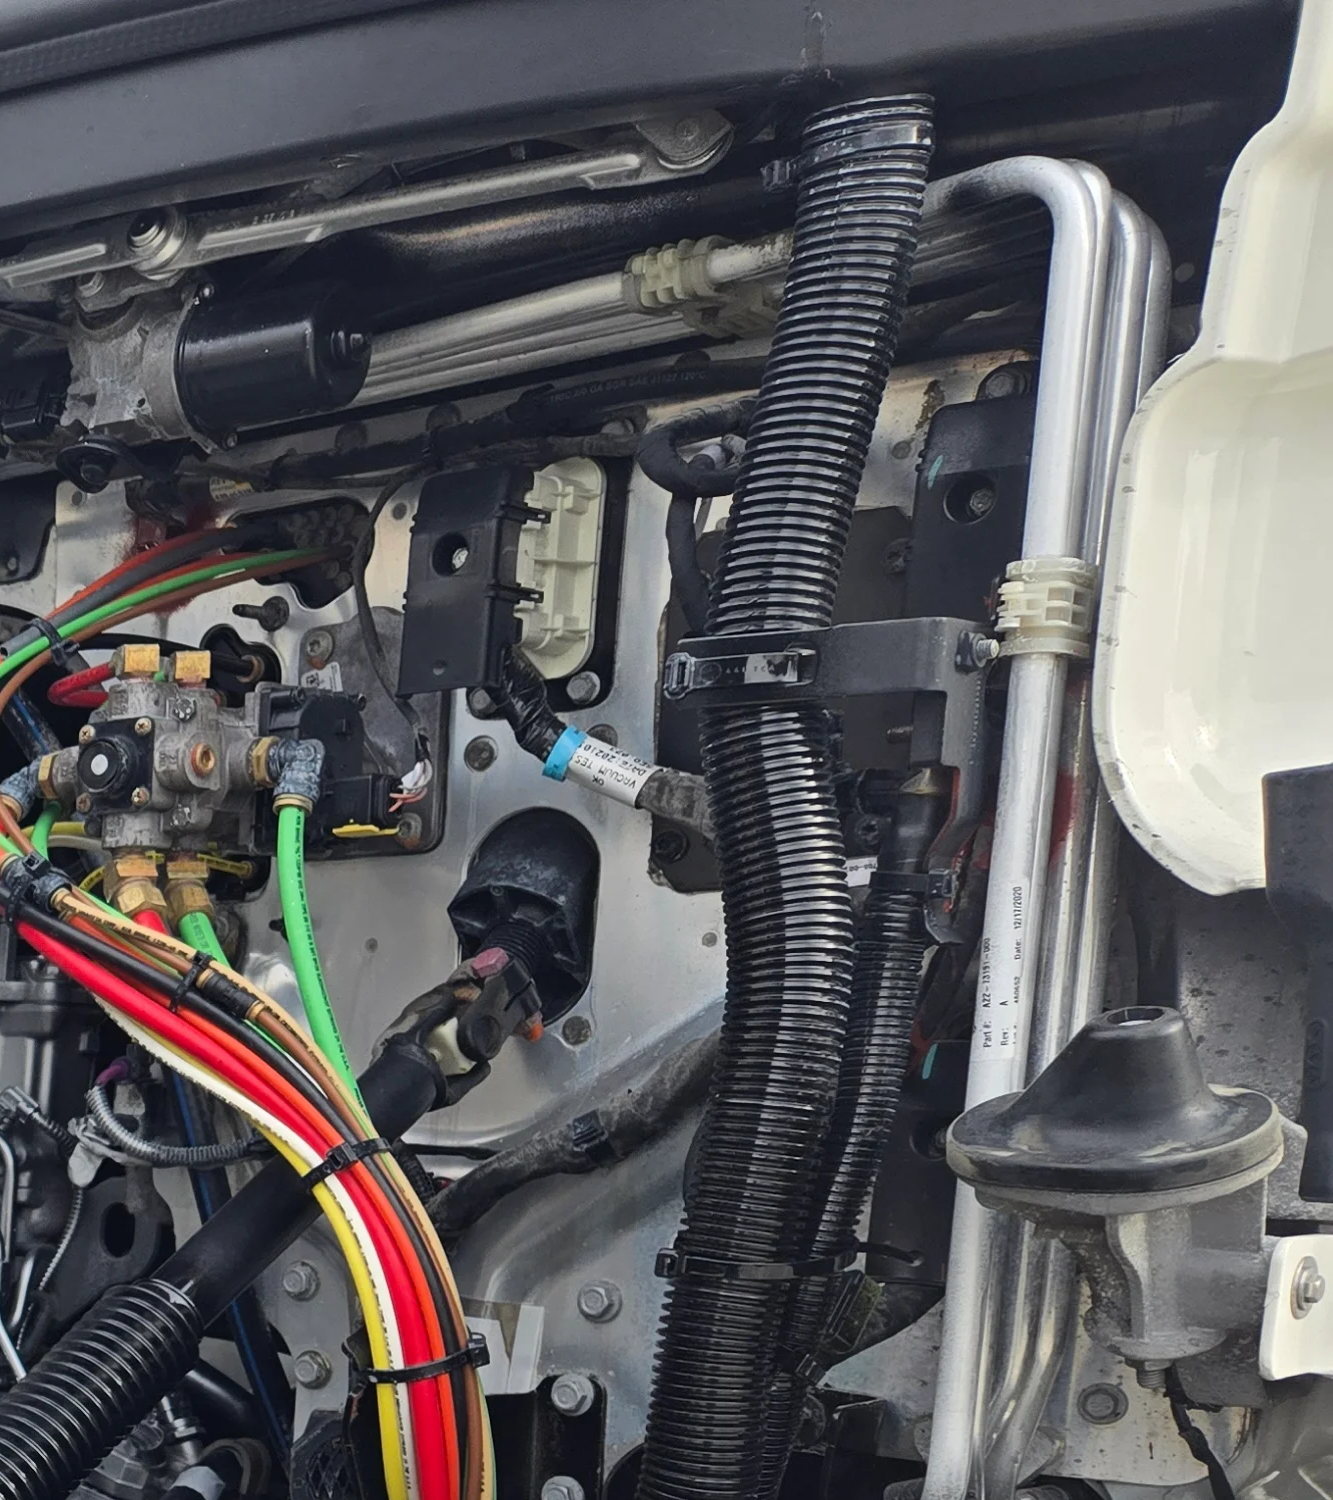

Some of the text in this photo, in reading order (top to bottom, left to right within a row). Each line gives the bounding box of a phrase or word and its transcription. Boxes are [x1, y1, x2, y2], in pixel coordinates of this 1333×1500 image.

[574, 754, 593, 770] TES
[592, 774, 605, 787] OK
[1012, 886, 1023, 930] 12/17/2020
[1014, 938, 1022, 960] Date:
